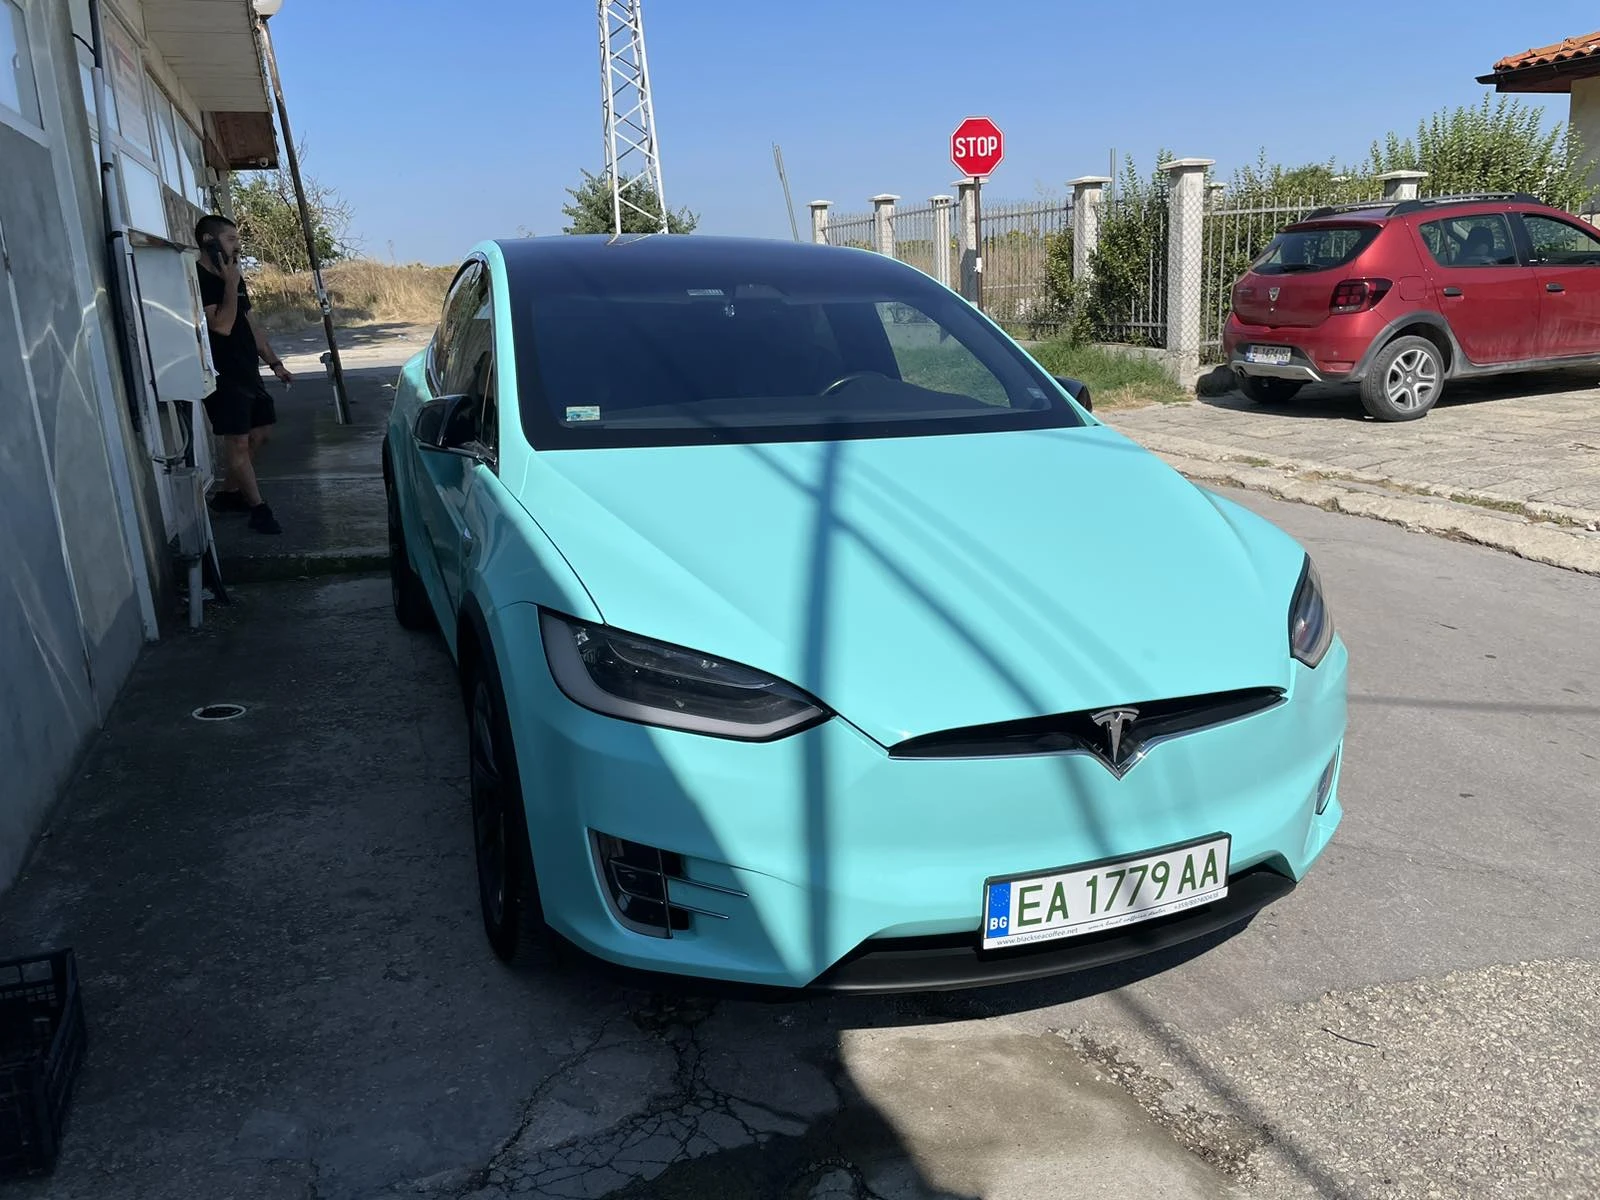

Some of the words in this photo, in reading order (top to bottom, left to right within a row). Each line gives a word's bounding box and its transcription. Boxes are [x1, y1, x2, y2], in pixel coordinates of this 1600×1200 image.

[955, 136, 998, 158] STOP
[1017, 882, 1069, 927] EA
[1086, 861, 1170, 915] 1779
[1177, 848, 1218, 895] AA
[989, 916, 1008, 930] BG
[996, 927, 1078, 946] www.blackseacoffee.net
